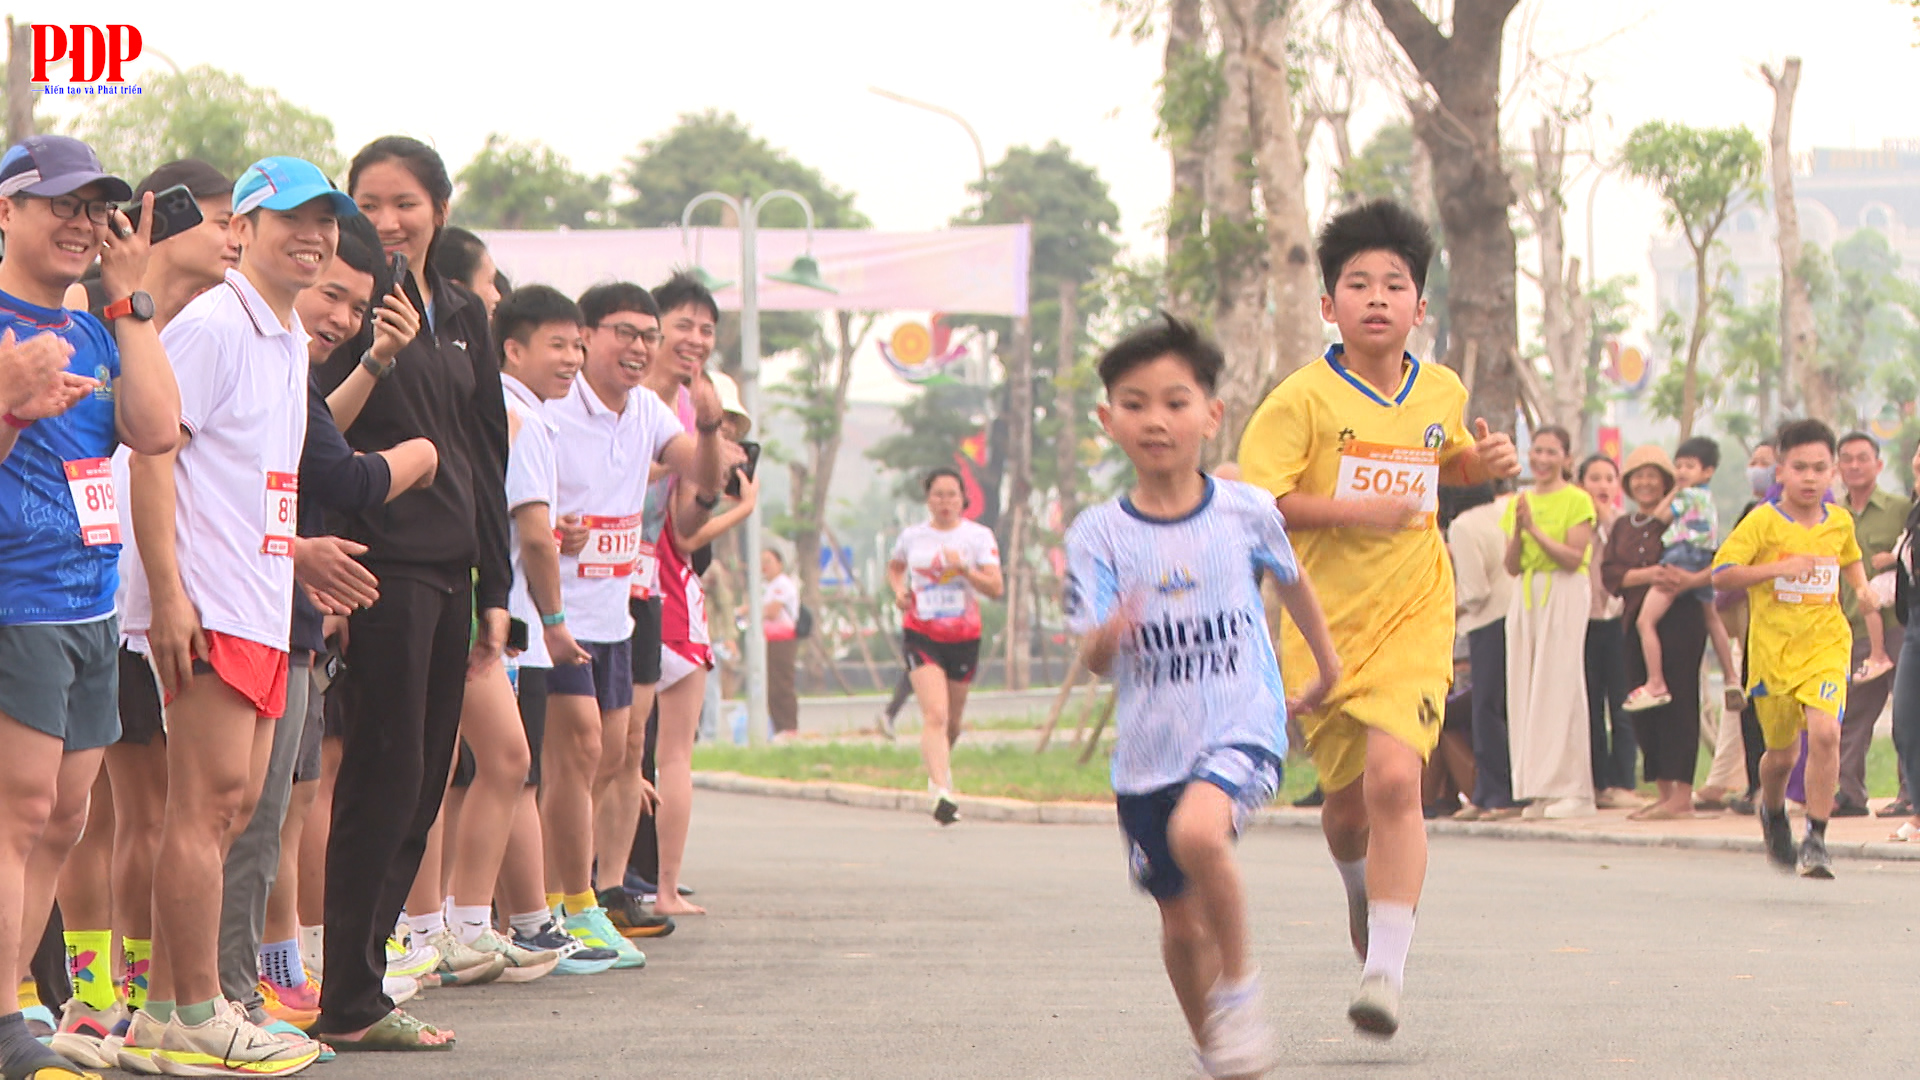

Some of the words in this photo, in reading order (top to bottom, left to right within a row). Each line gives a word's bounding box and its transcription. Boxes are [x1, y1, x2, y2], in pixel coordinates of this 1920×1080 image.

[1351, 466, 1427, 497] 5054
[597, 532, 636, 554] 8119
[1820, 680, 1838, 700] 12
